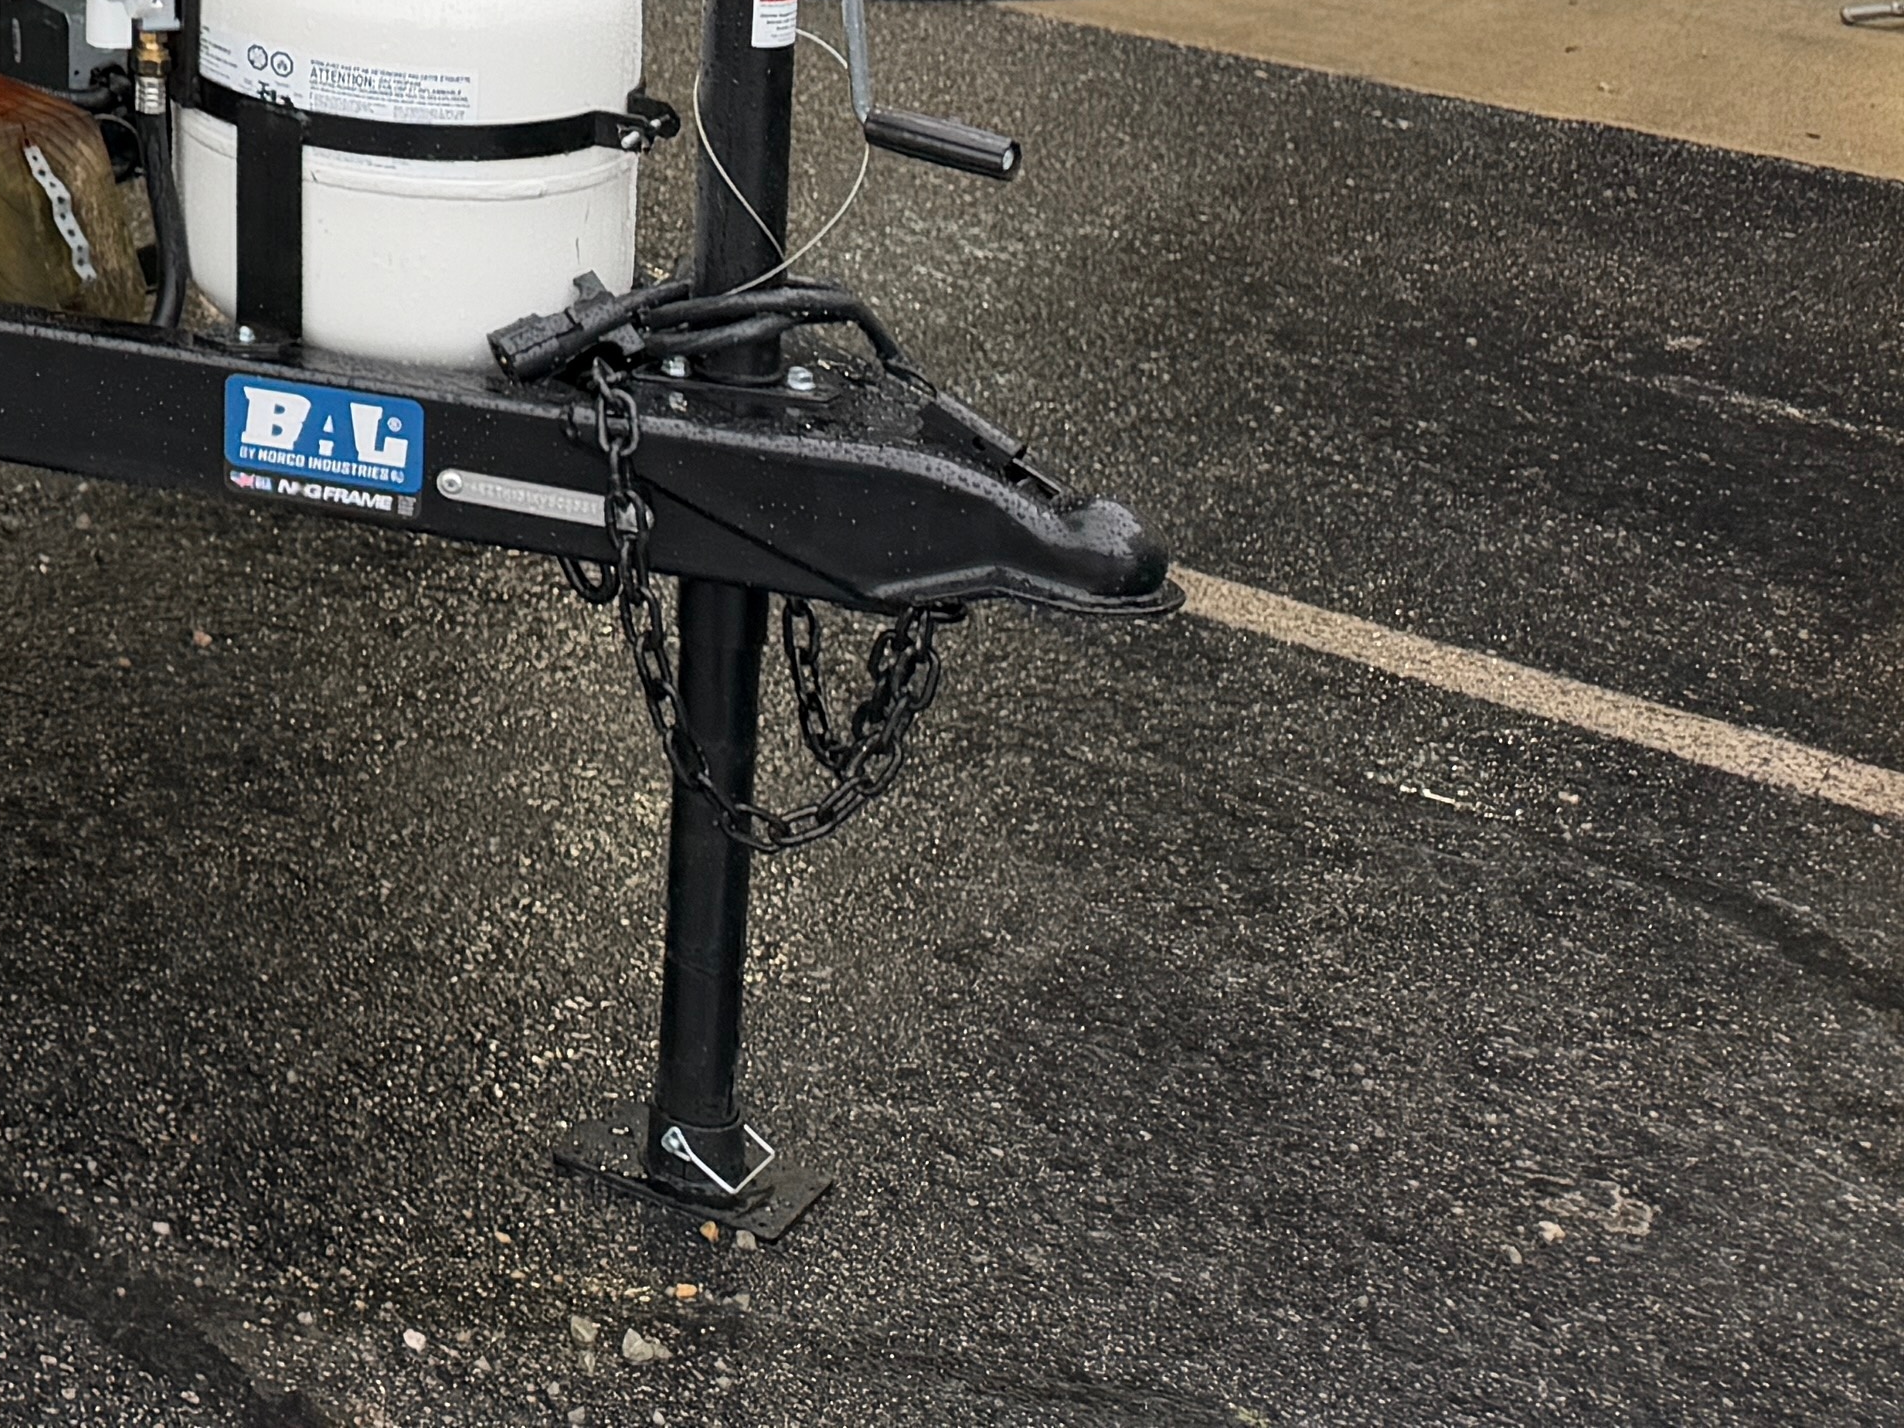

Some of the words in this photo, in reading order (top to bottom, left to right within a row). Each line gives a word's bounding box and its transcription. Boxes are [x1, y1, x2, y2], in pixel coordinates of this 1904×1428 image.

[240, 445, 255, 459] BY
[308, 456, 391, 481] INDUSTRIES
[323, 484, 394, 511] FRAME
